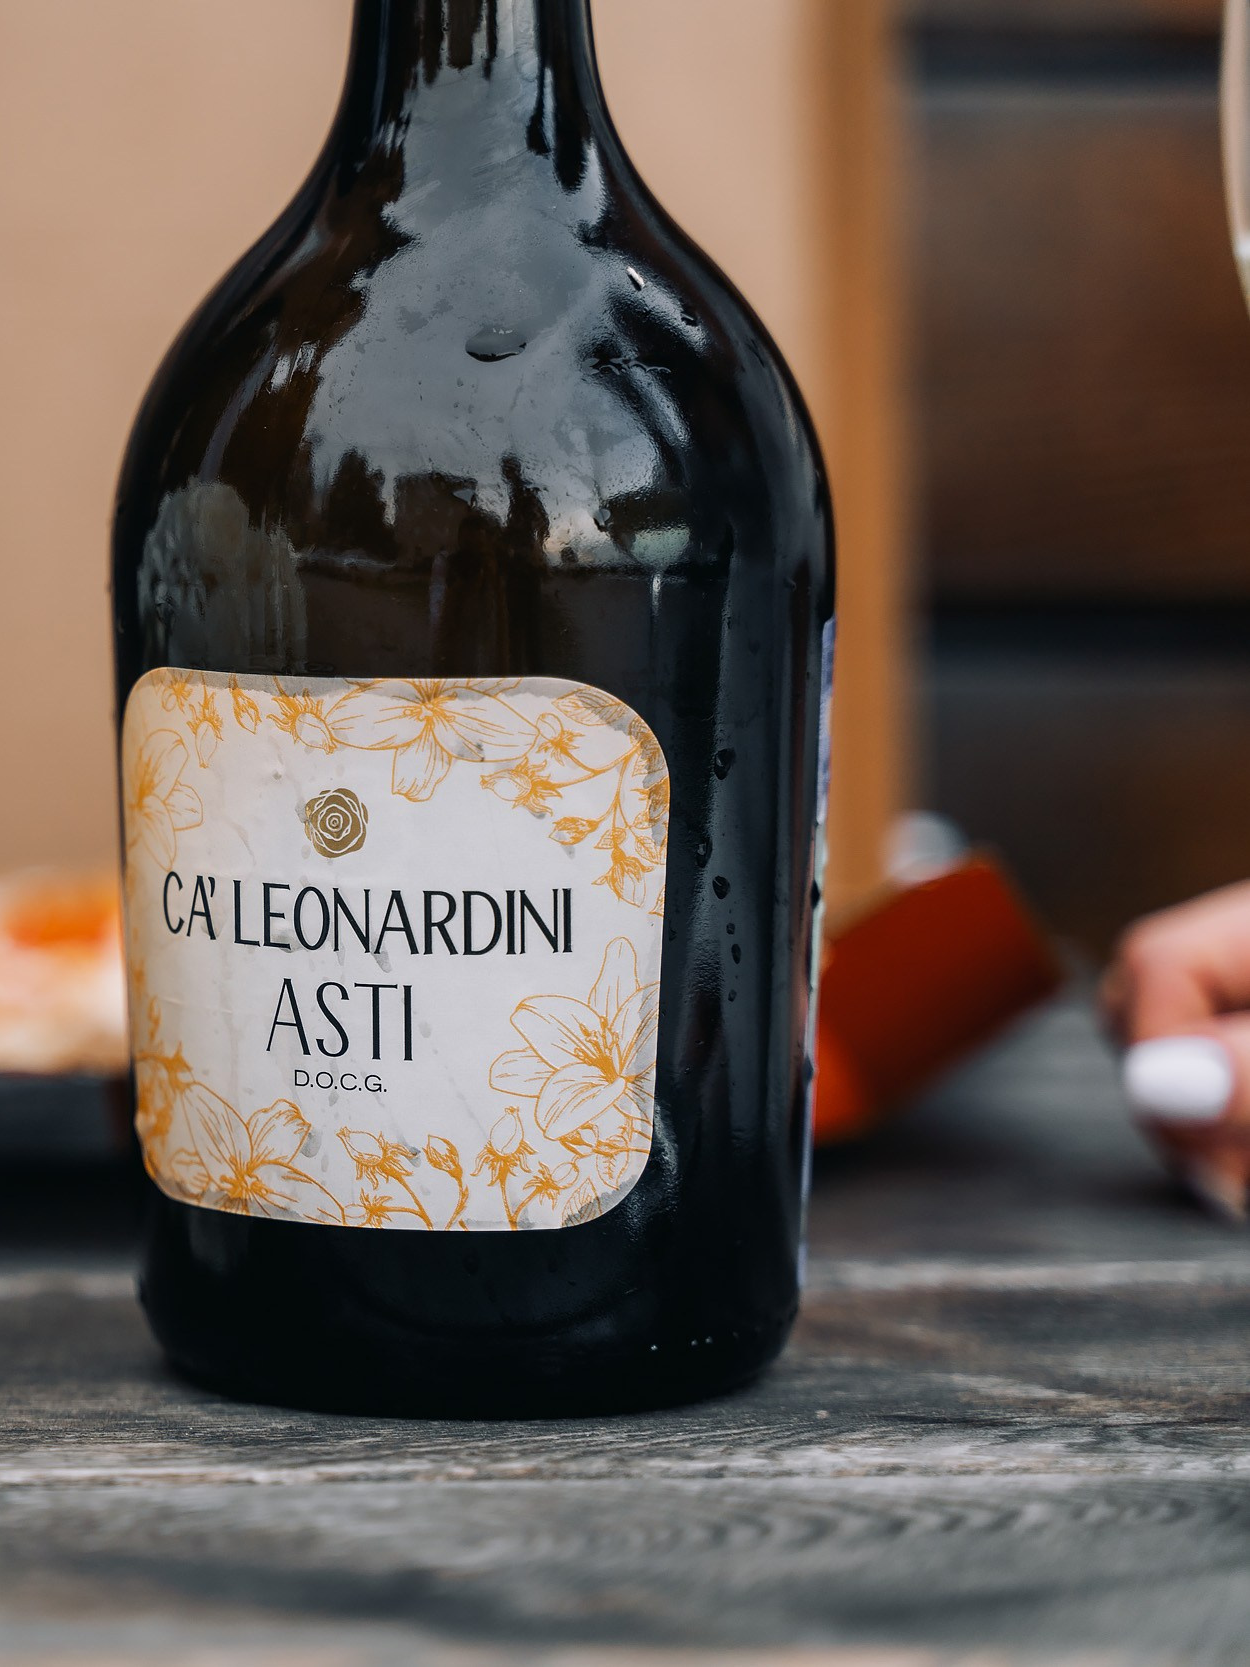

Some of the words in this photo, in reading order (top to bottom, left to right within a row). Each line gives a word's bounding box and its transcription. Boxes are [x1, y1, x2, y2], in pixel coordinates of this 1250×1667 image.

[162, 870, 218, 941] CA'
[232, 879, 573, 956] LEONARDINI
[266, 977, 414, 1062] ASTI
[294, 1069, 388, 1093] D.O.C.G.
